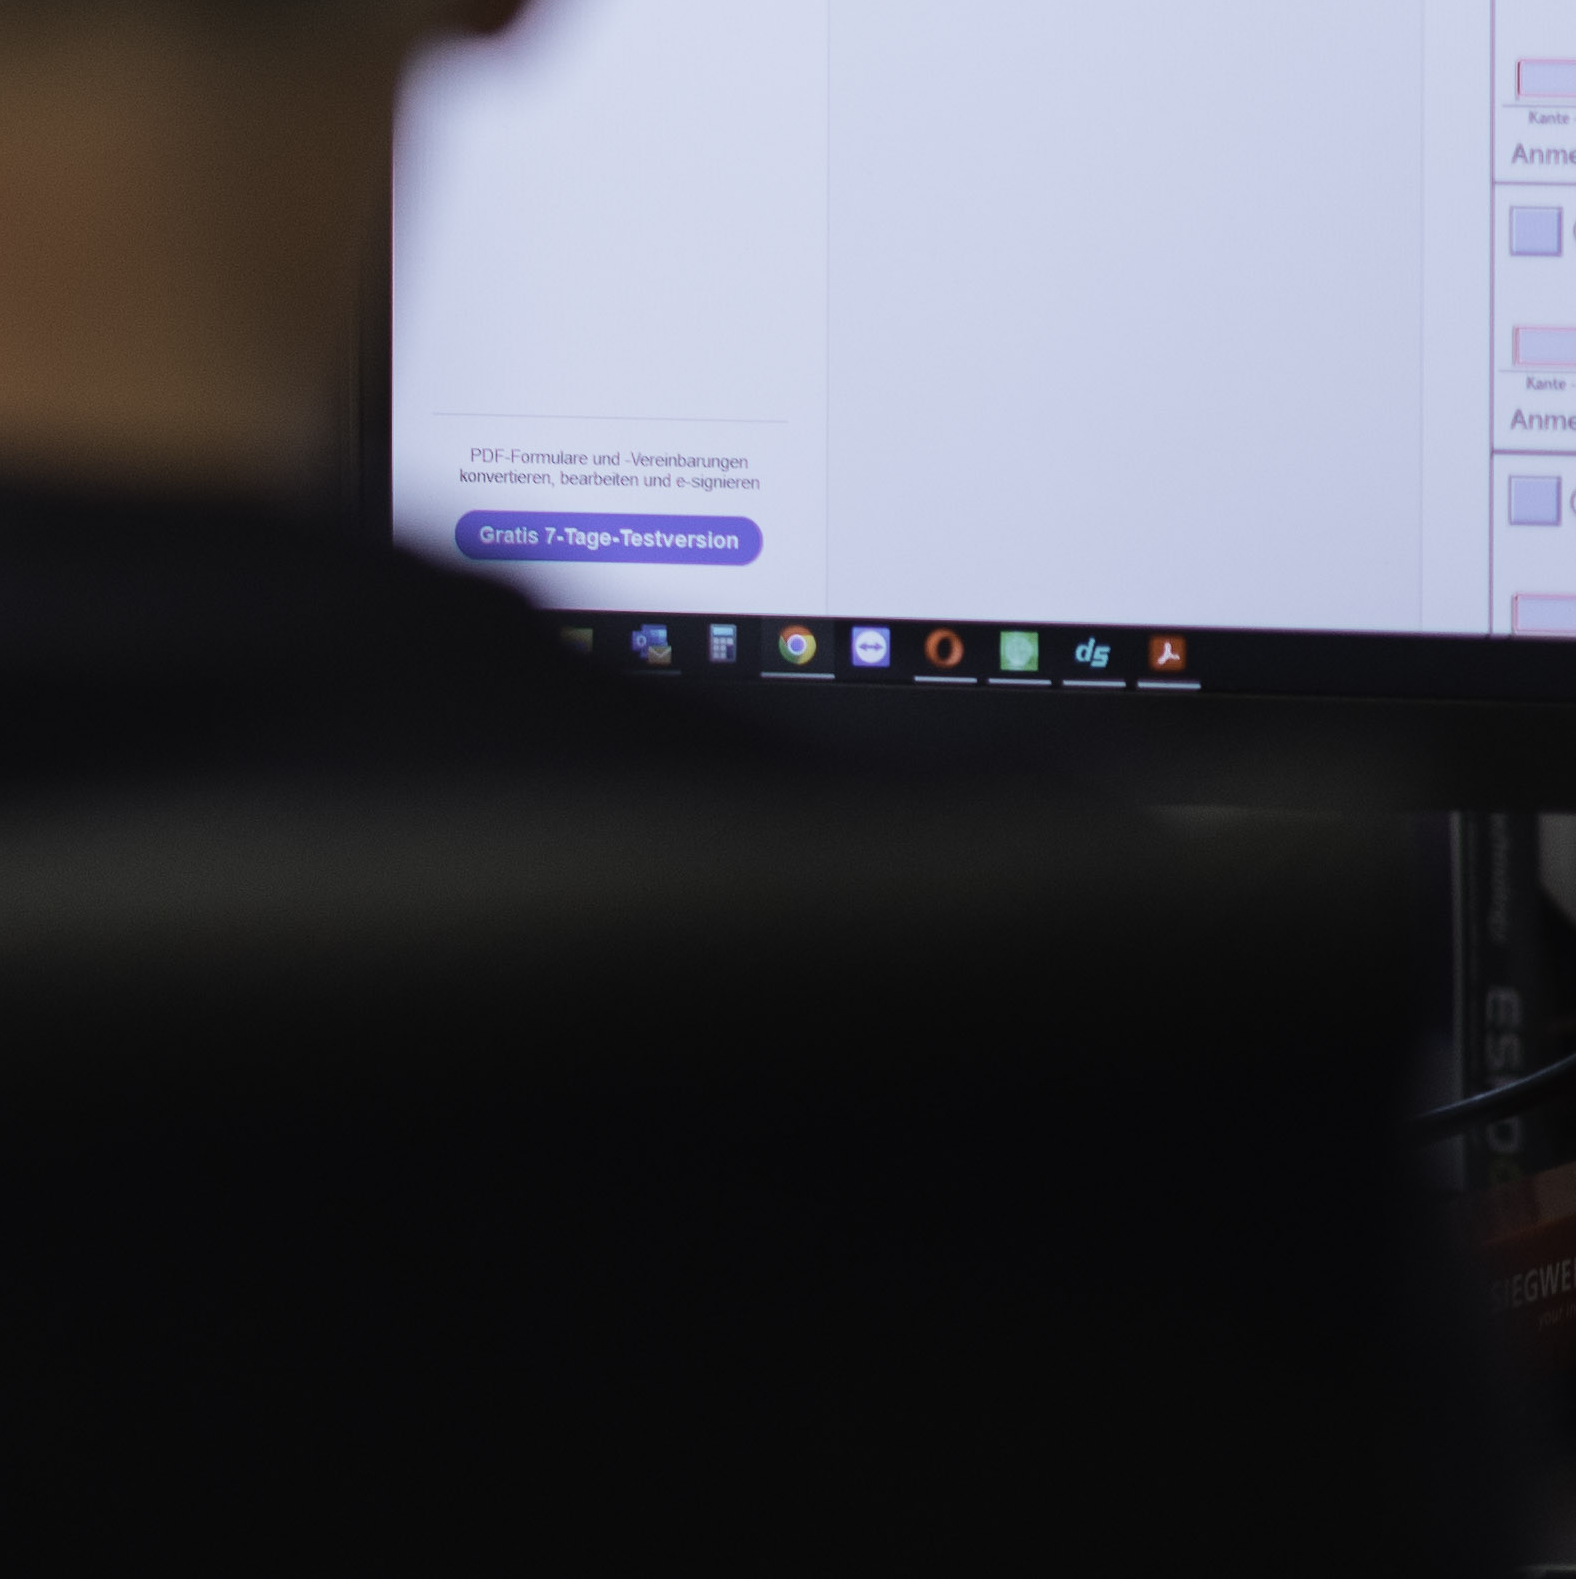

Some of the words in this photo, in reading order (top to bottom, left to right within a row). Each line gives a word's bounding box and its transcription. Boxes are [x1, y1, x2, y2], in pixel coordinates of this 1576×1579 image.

[1528, 111, 1569, 125] Kante
[1526, 376, 1565, 390] Kante
[470, 447, 588, 464] PDF-Formulare
[593, 451, 620, 465] und
[626, 452, 748, 472] -Vereinbarungen
[459, 468, 554, 485] konvertieren,
[560, 471, 638, 486] bearbeiten
[643, 473, 671, 487] und
[676, 477, 759, 492] e-signieren
[479, 526, 539, 544] Gratis
[545, 527, 739, 554] 7-Tage-Testversion
